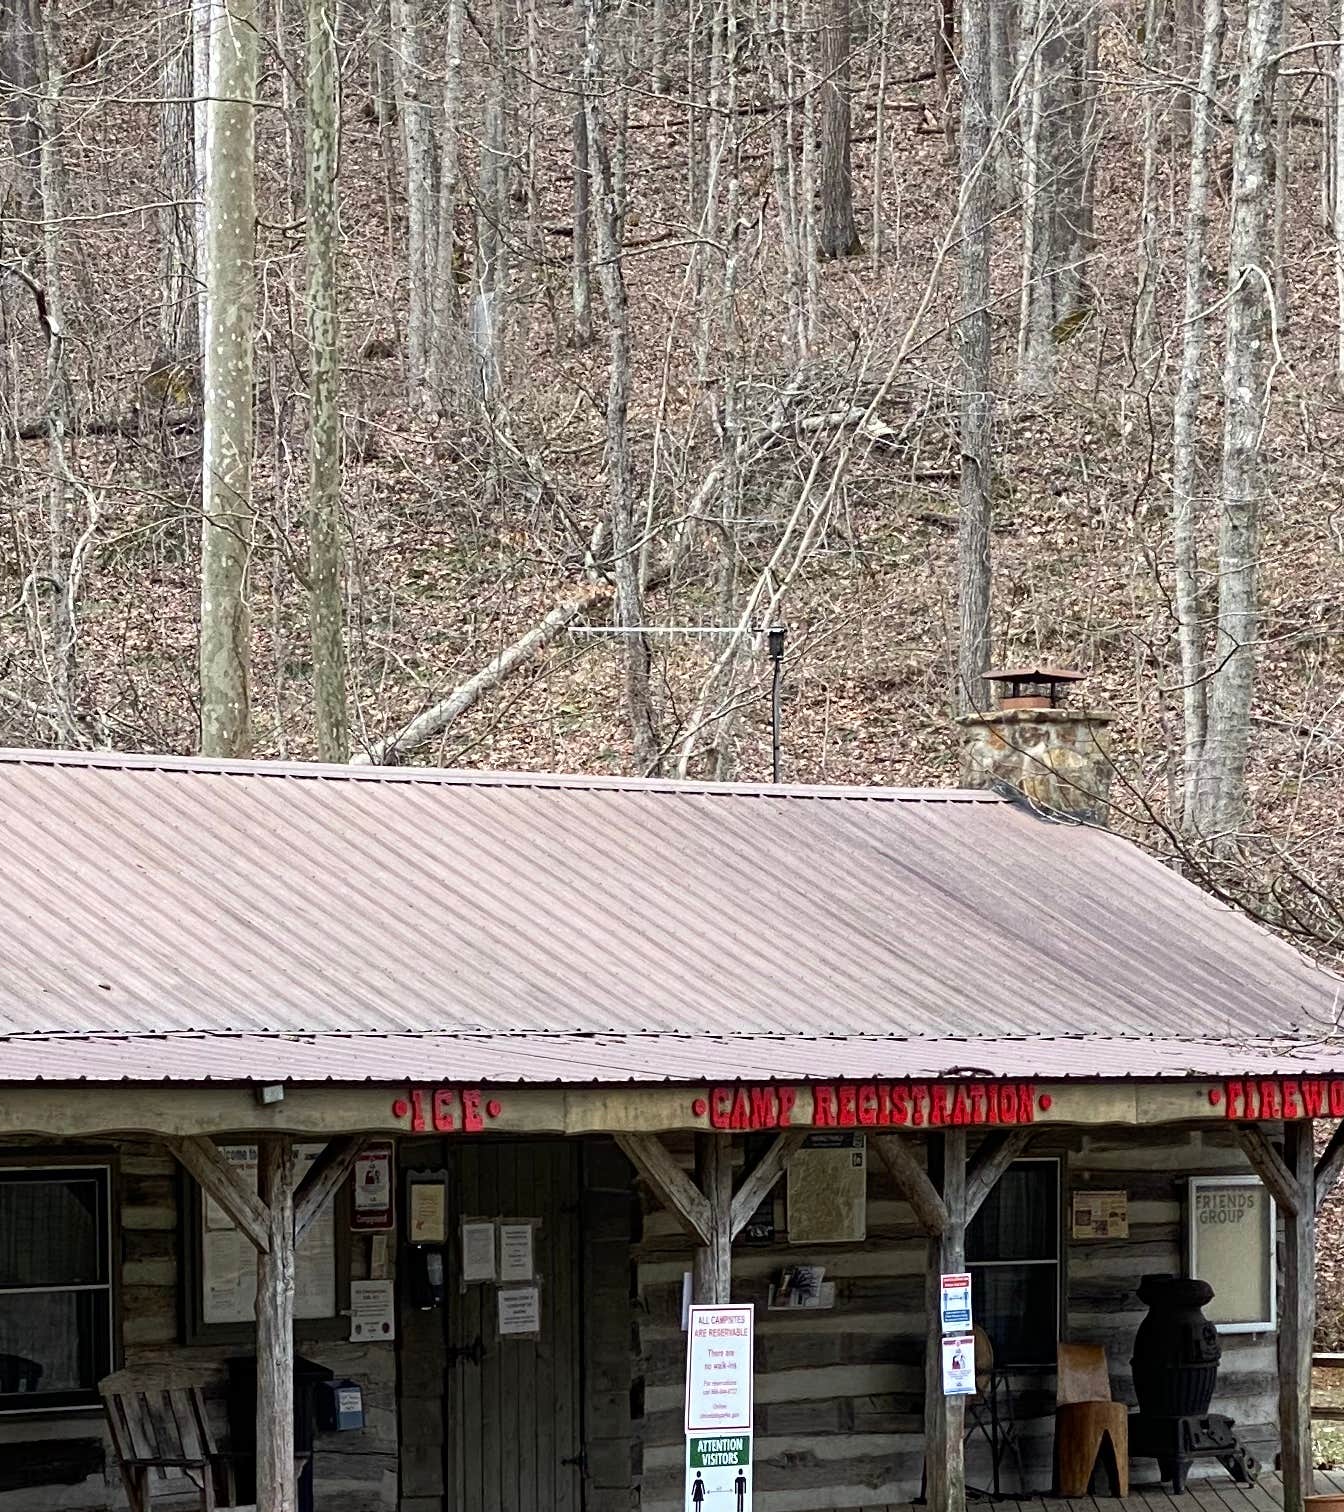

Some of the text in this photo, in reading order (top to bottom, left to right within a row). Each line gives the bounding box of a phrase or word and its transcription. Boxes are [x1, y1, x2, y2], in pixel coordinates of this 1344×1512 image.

[410, 1088, 484, 1133] ICE
[709, 1083, 1036, 1130] CAMP REGISTRATION
[1195, 1193, 1255, 1210] FRIENDS
[1199, 1208, 1245, 1225] GROUP
[698, 1316, 710, 1325] ALL
[695, 1328, 707, 1337] ARE
[697, 1438, 743, 1453] ATTENTION
[701, 1451, 739, 1466] VISITORS
